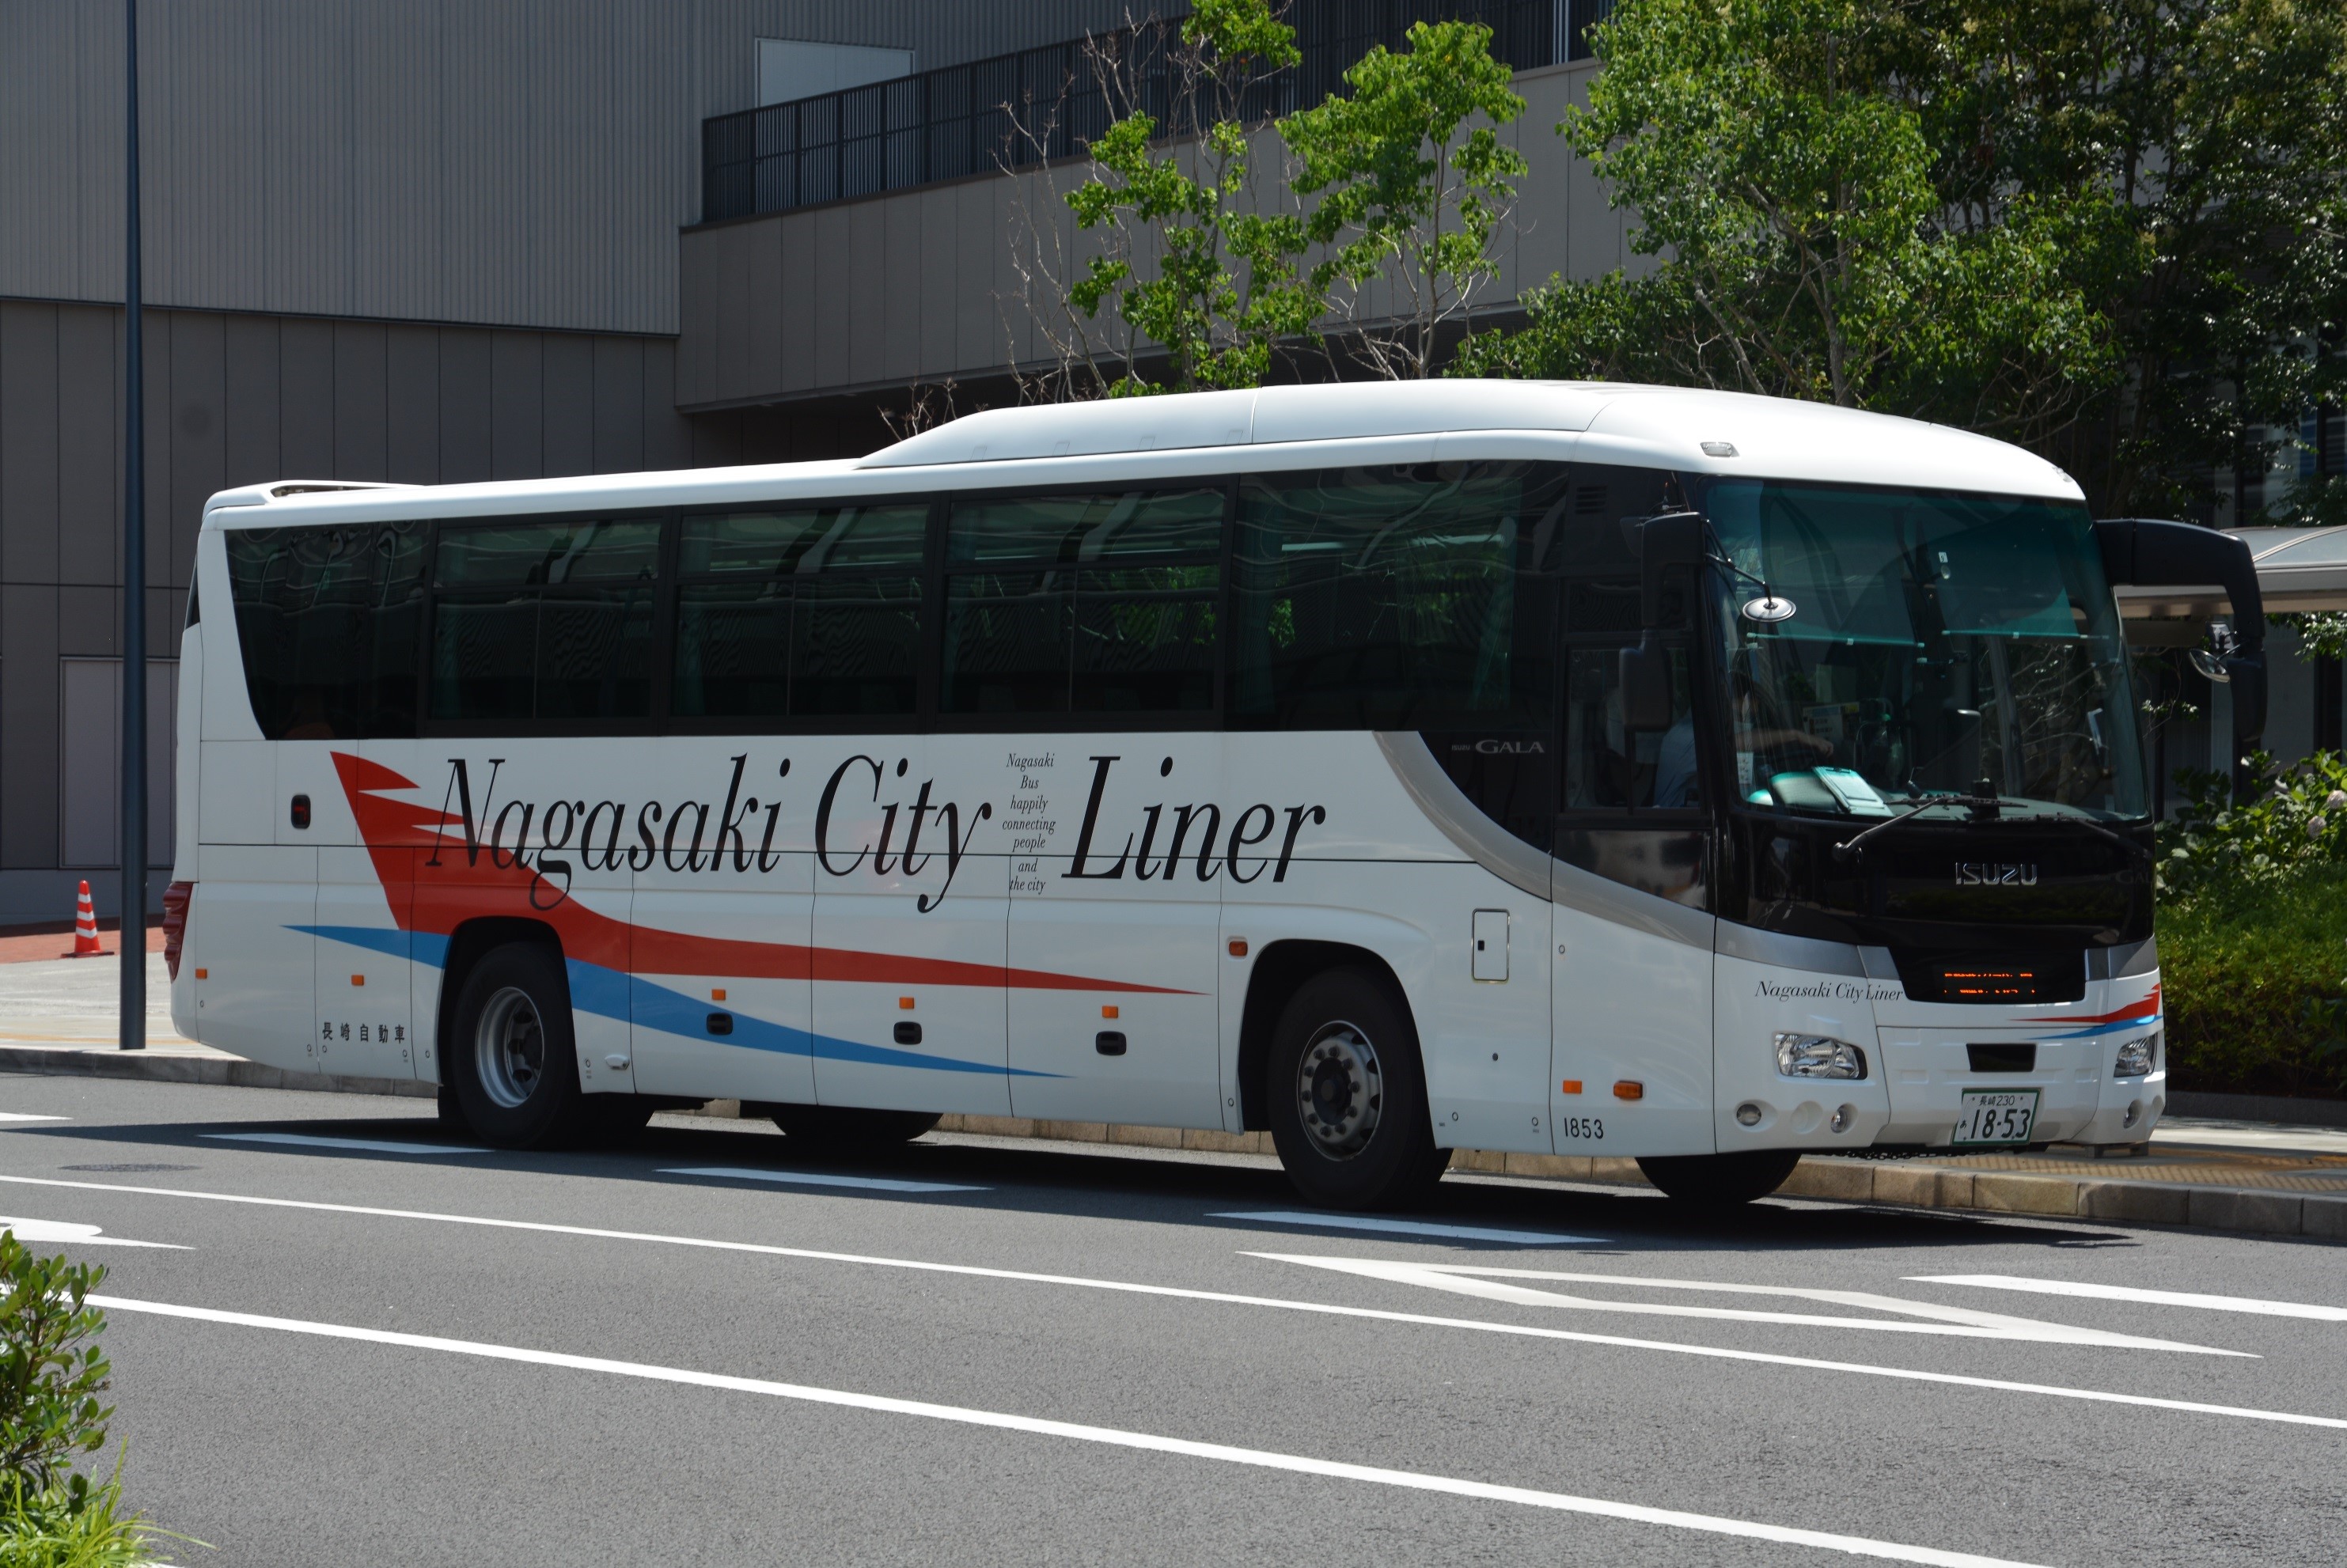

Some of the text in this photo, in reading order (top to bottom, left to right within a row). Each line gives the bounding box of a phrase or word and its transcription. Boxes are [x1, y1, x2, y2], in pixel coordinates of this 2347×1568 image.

[1475, 739, 1545, 754] GALA
[1006, 752, 1055, 772] Nagasaki
[1020, 775, 1039, 790] Bus
[1010, 794, 1048, 814] happily
[425, 752, 1326, 914] Nagasaki City Liner
[1002, 816, 1056, 835] connecting
[1011, 833, 1046, 853] people
[1018, 858, 1038, 873] and
[1955, 862, 2038, 886] ISUZU
[1009, 876, 1046, 895] the city
[1754, 980, 1904, 1004] Nagasaki City Liner
[1564, 1117, 1604, 1139] 1853
